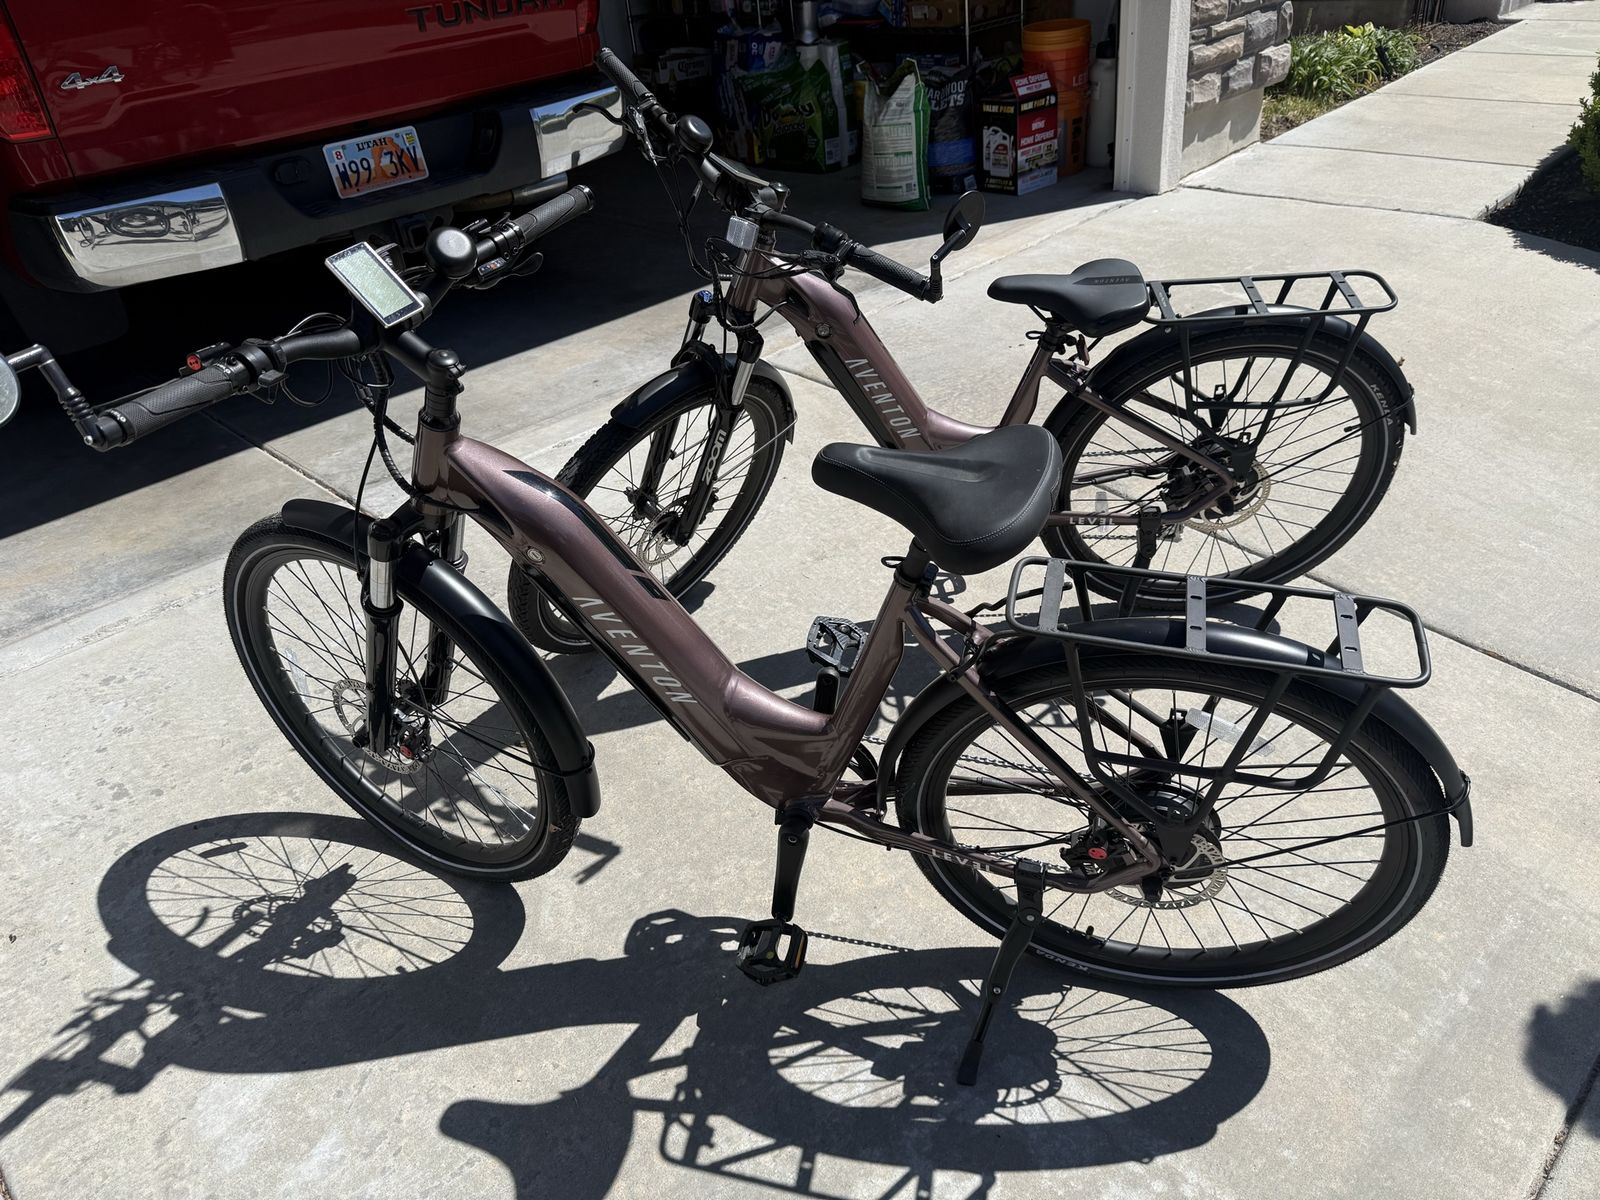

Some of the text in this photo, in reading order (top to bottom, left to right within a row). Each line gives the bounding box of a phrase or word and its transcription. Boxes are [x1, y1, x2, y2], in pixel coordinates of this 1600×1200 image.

[356, 138, 389, 152] UTAH
[335, 150, 343, 160] 8
[844, 358, 921, 439] AVENTON
[1069, 517, 1116, 526] LEVEL
[572, 596, 698, 704] AVENTON
